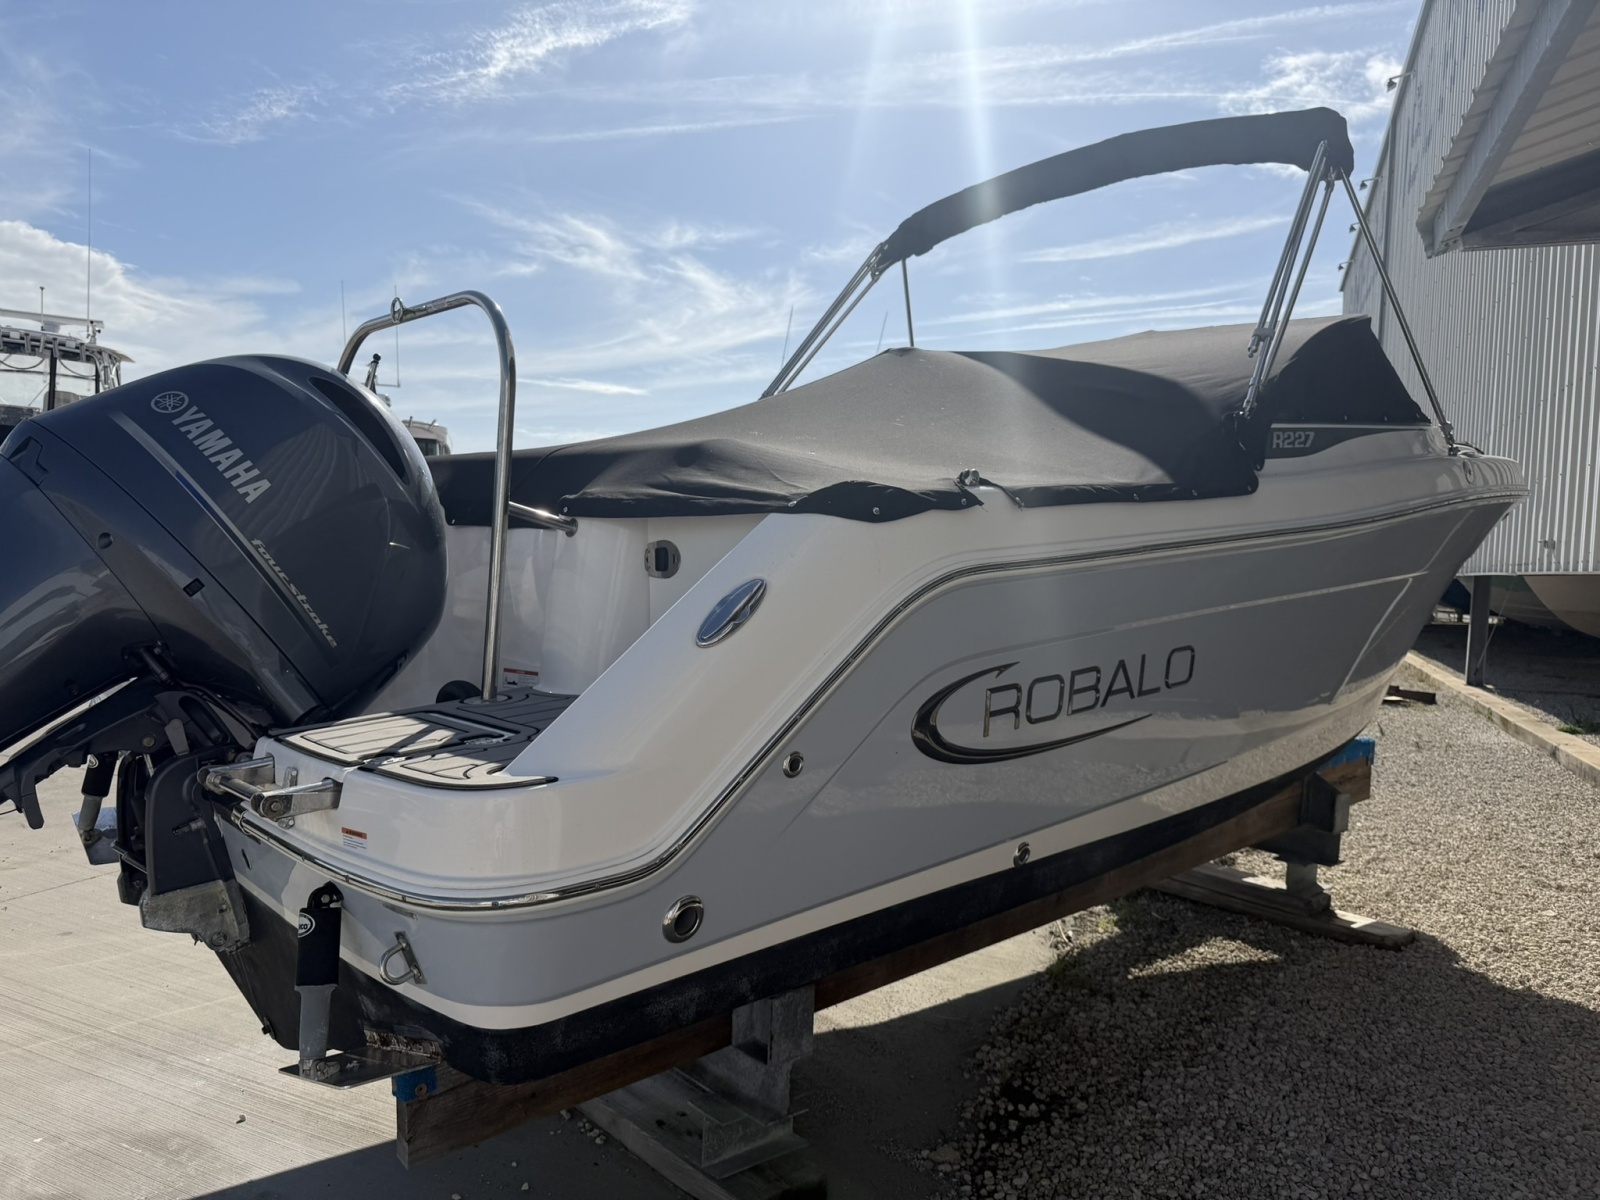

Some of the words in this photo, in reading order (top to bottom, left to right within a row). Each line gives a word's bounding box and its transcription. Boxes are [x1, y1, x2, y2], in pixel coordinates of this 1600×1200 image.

[172, 406, 272, 504] YAMAHA
[1272, 431, 1315, 449] R227
[251, 538, 338, 648] fourstroke
[982, 645, 1196, 738] ROBALO
